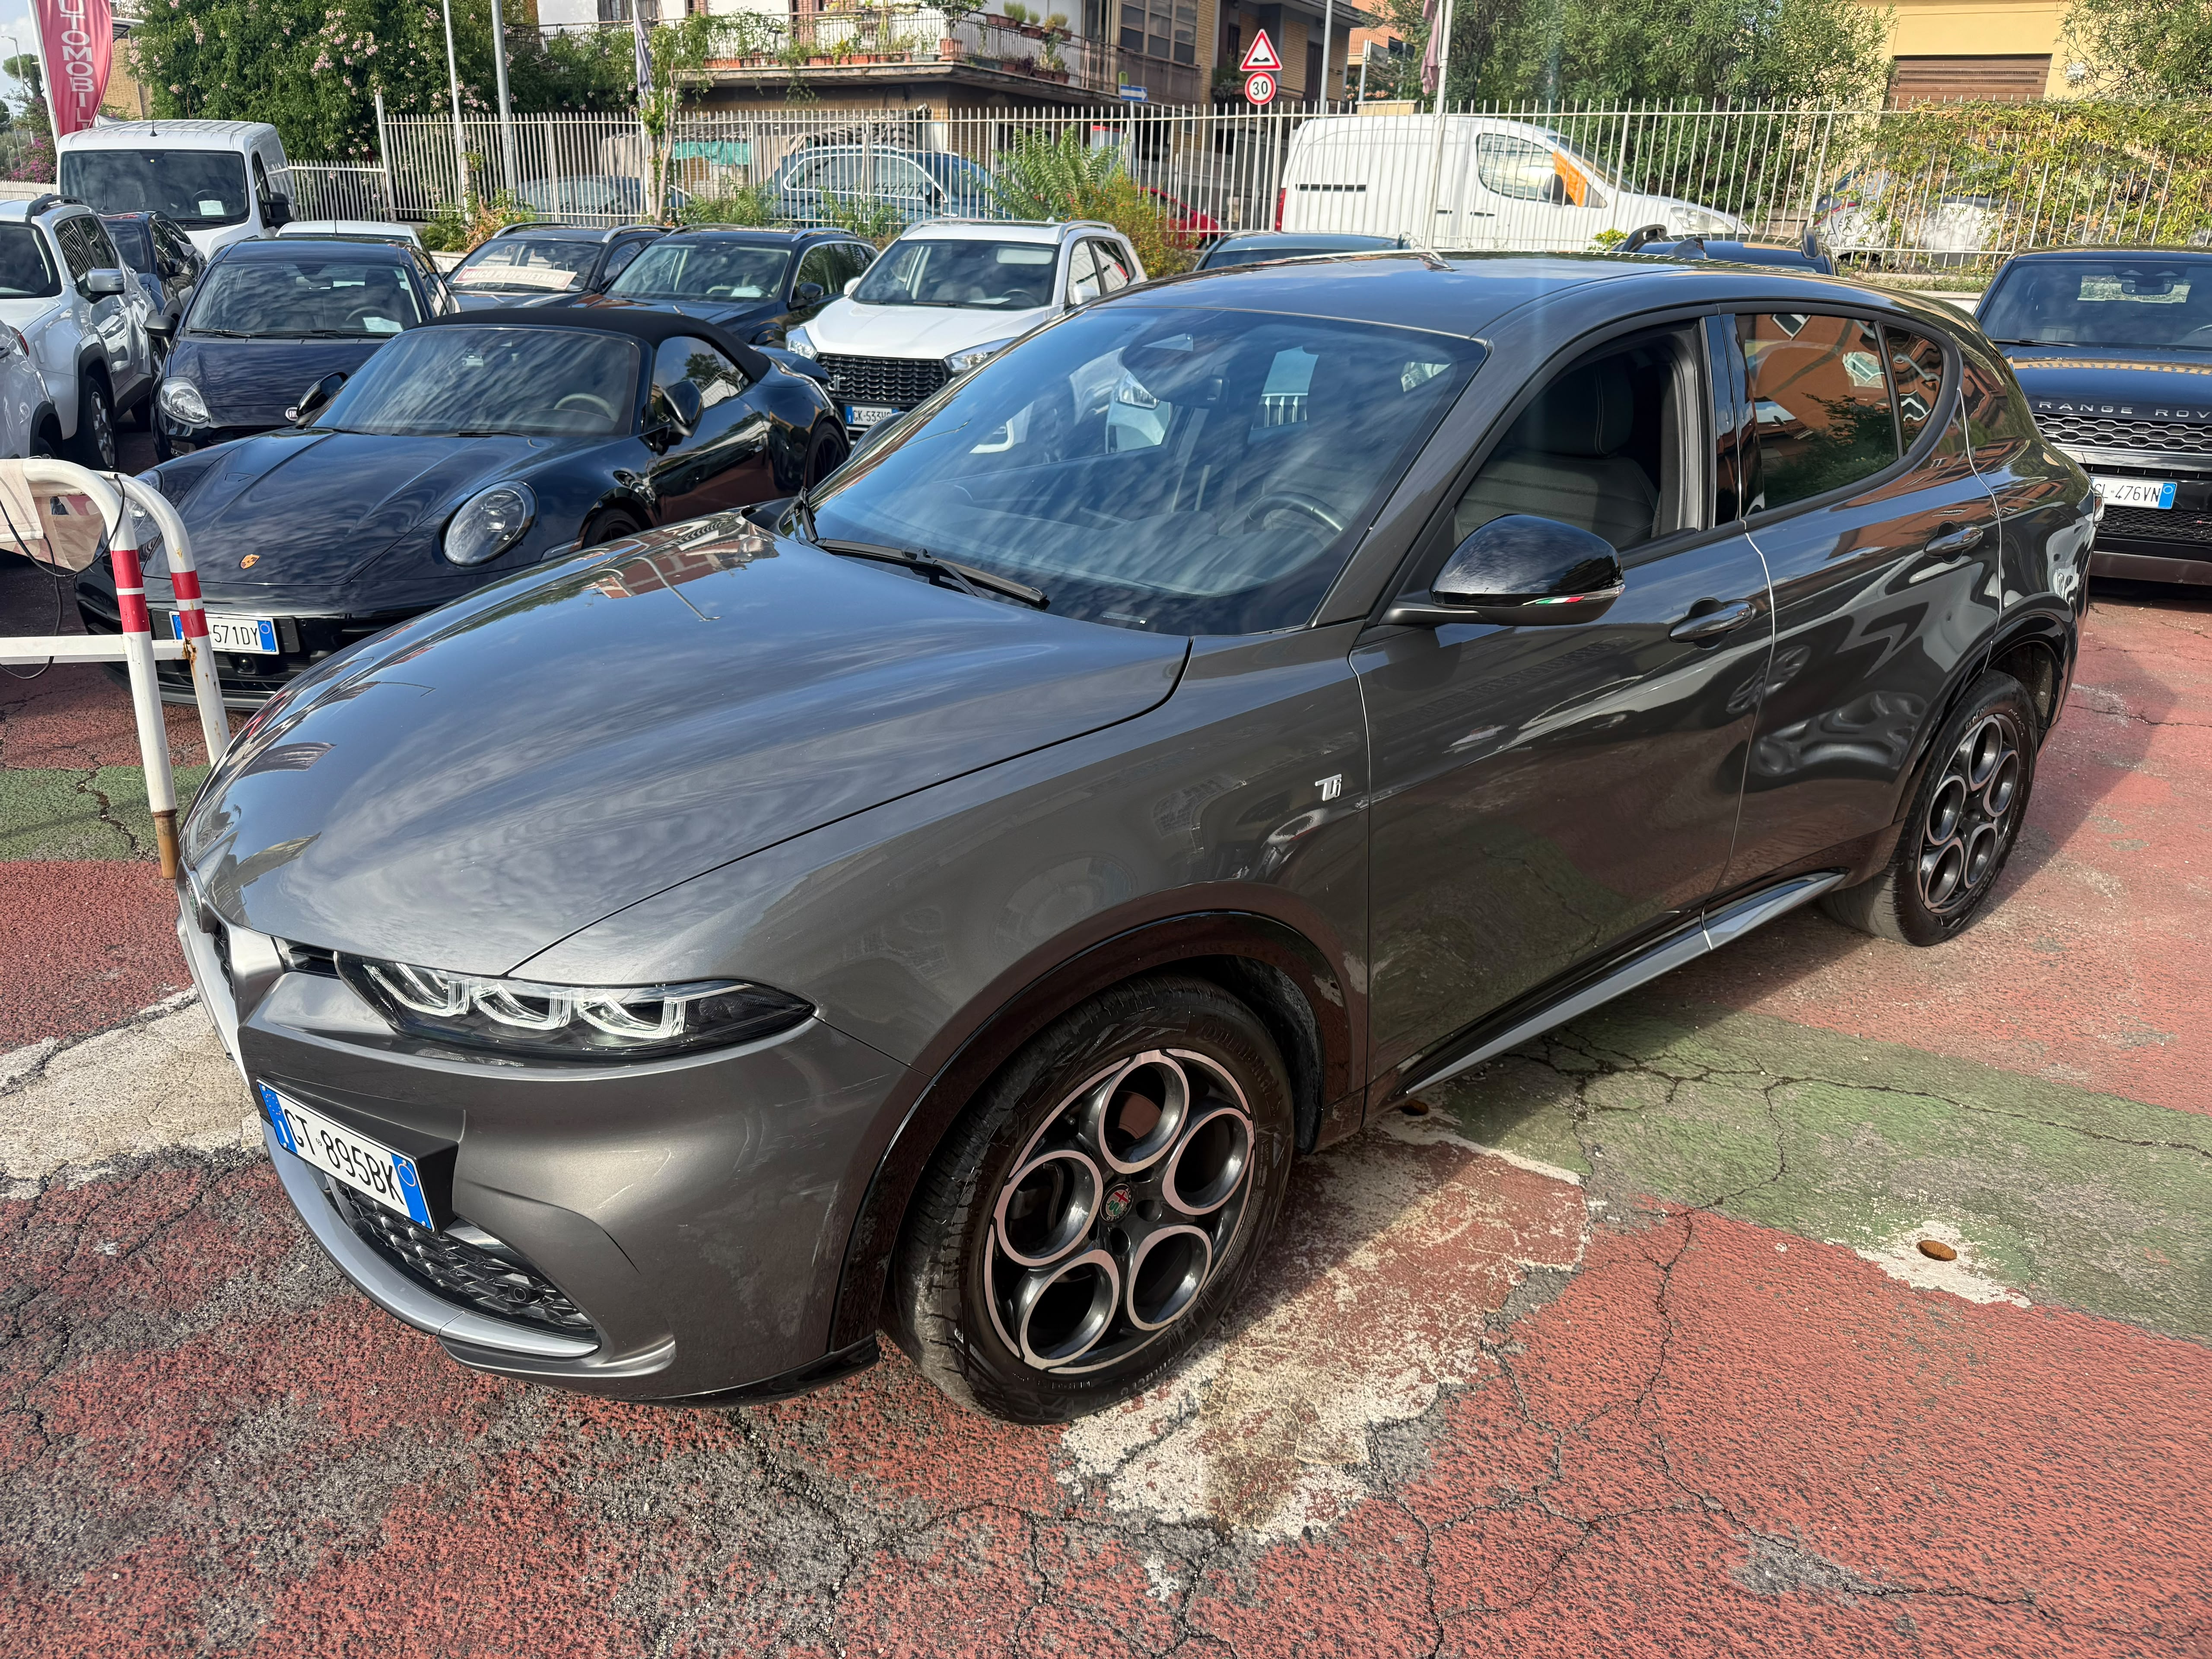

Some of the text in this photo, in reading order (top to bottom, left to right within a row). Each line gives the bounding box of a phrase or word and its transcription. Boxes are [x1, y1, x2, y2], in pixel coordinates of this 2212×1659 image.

[1253, 81, 1268, 95] 30
[462, 270, 566, 284] UNICO PROPRIETARIO
[853, 410, 863, 421] GK
[2039, 401, 2211, 418] RANGE ROV
[2115, 485, 2161, 502] 476VN
[213, 624, 258, 646] 571DY
[1315, 774, 1342, 801] Ti
[284, 1109, 405, 1205] GT 895BK
